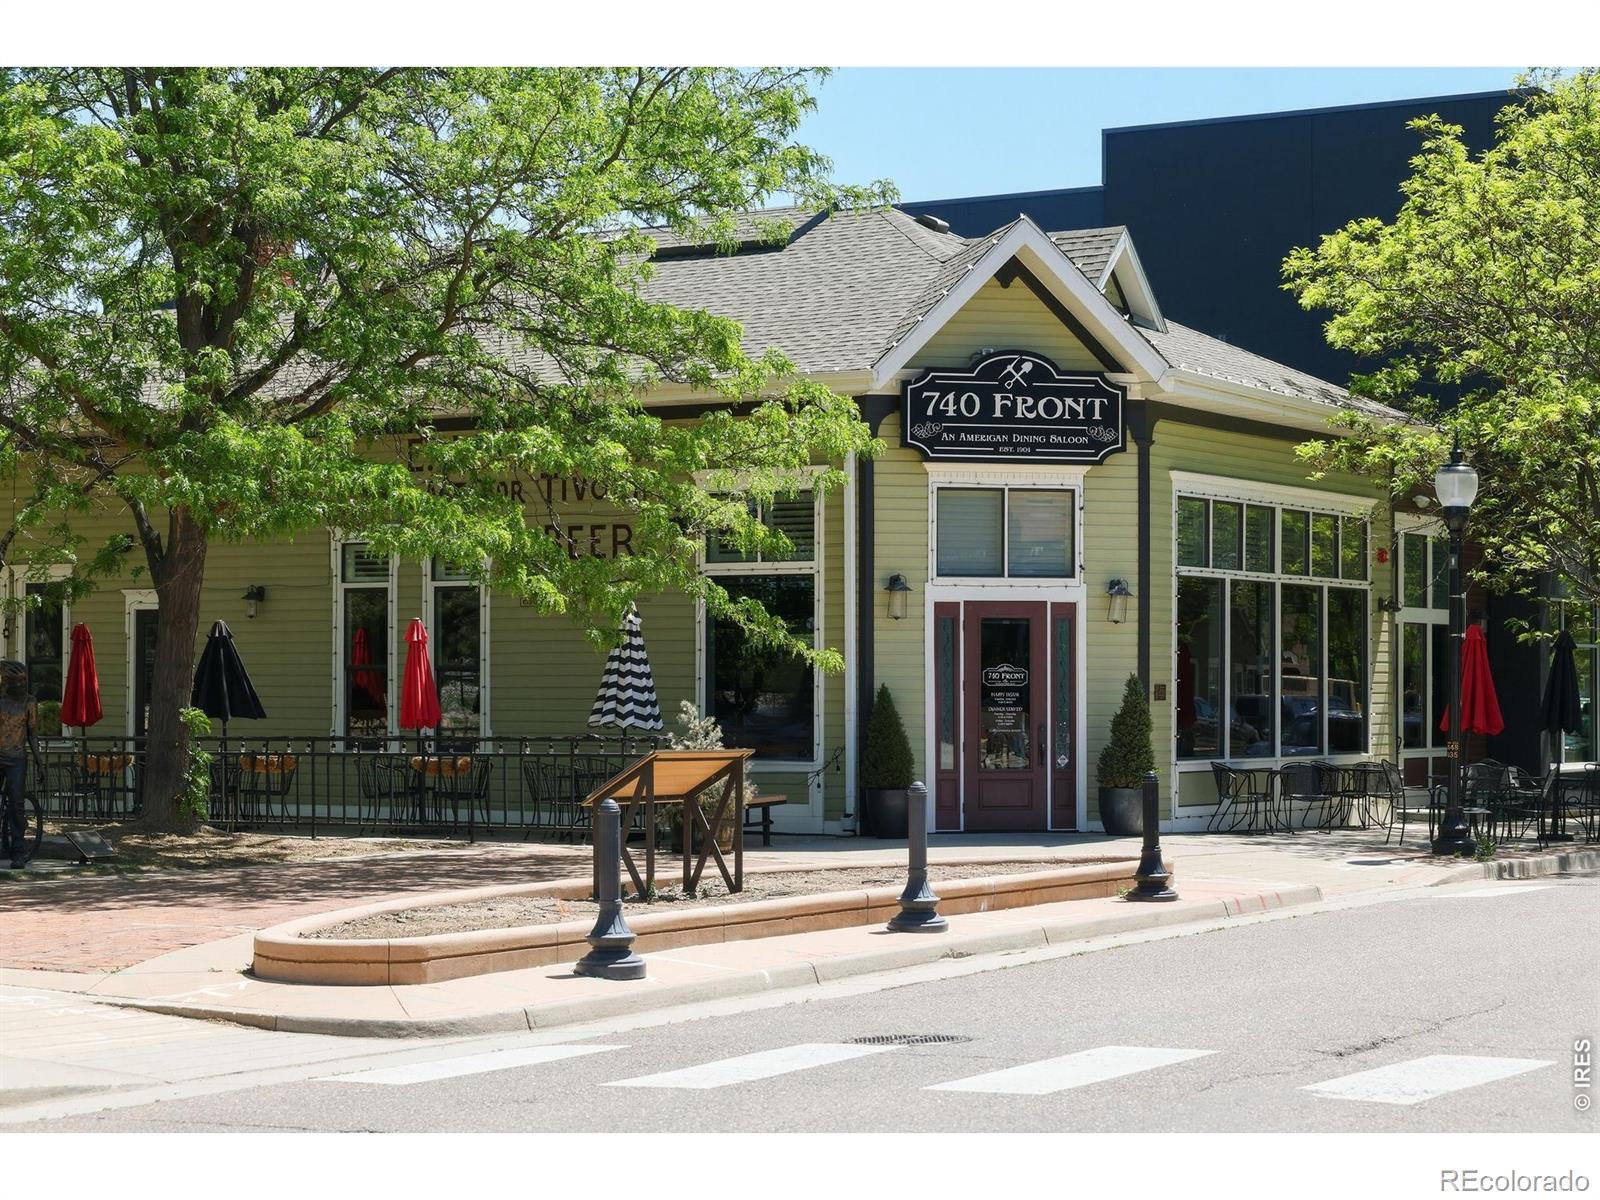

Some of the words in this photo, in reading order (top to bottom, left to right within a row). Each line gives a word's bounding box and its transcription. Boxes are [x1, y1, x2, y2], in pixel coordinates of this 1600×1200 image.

[922, 391, 981, 417] 740
[992, 393, 1109, 420] FRONT
[941, 432, 956, 441] AN
[1012, 433, 1047, 443] DINING
[1049, 434, 1089, 444] SALOON
[988, 672, 1000, 680] 740
[1001, 672, 1025, 680] FRONT
